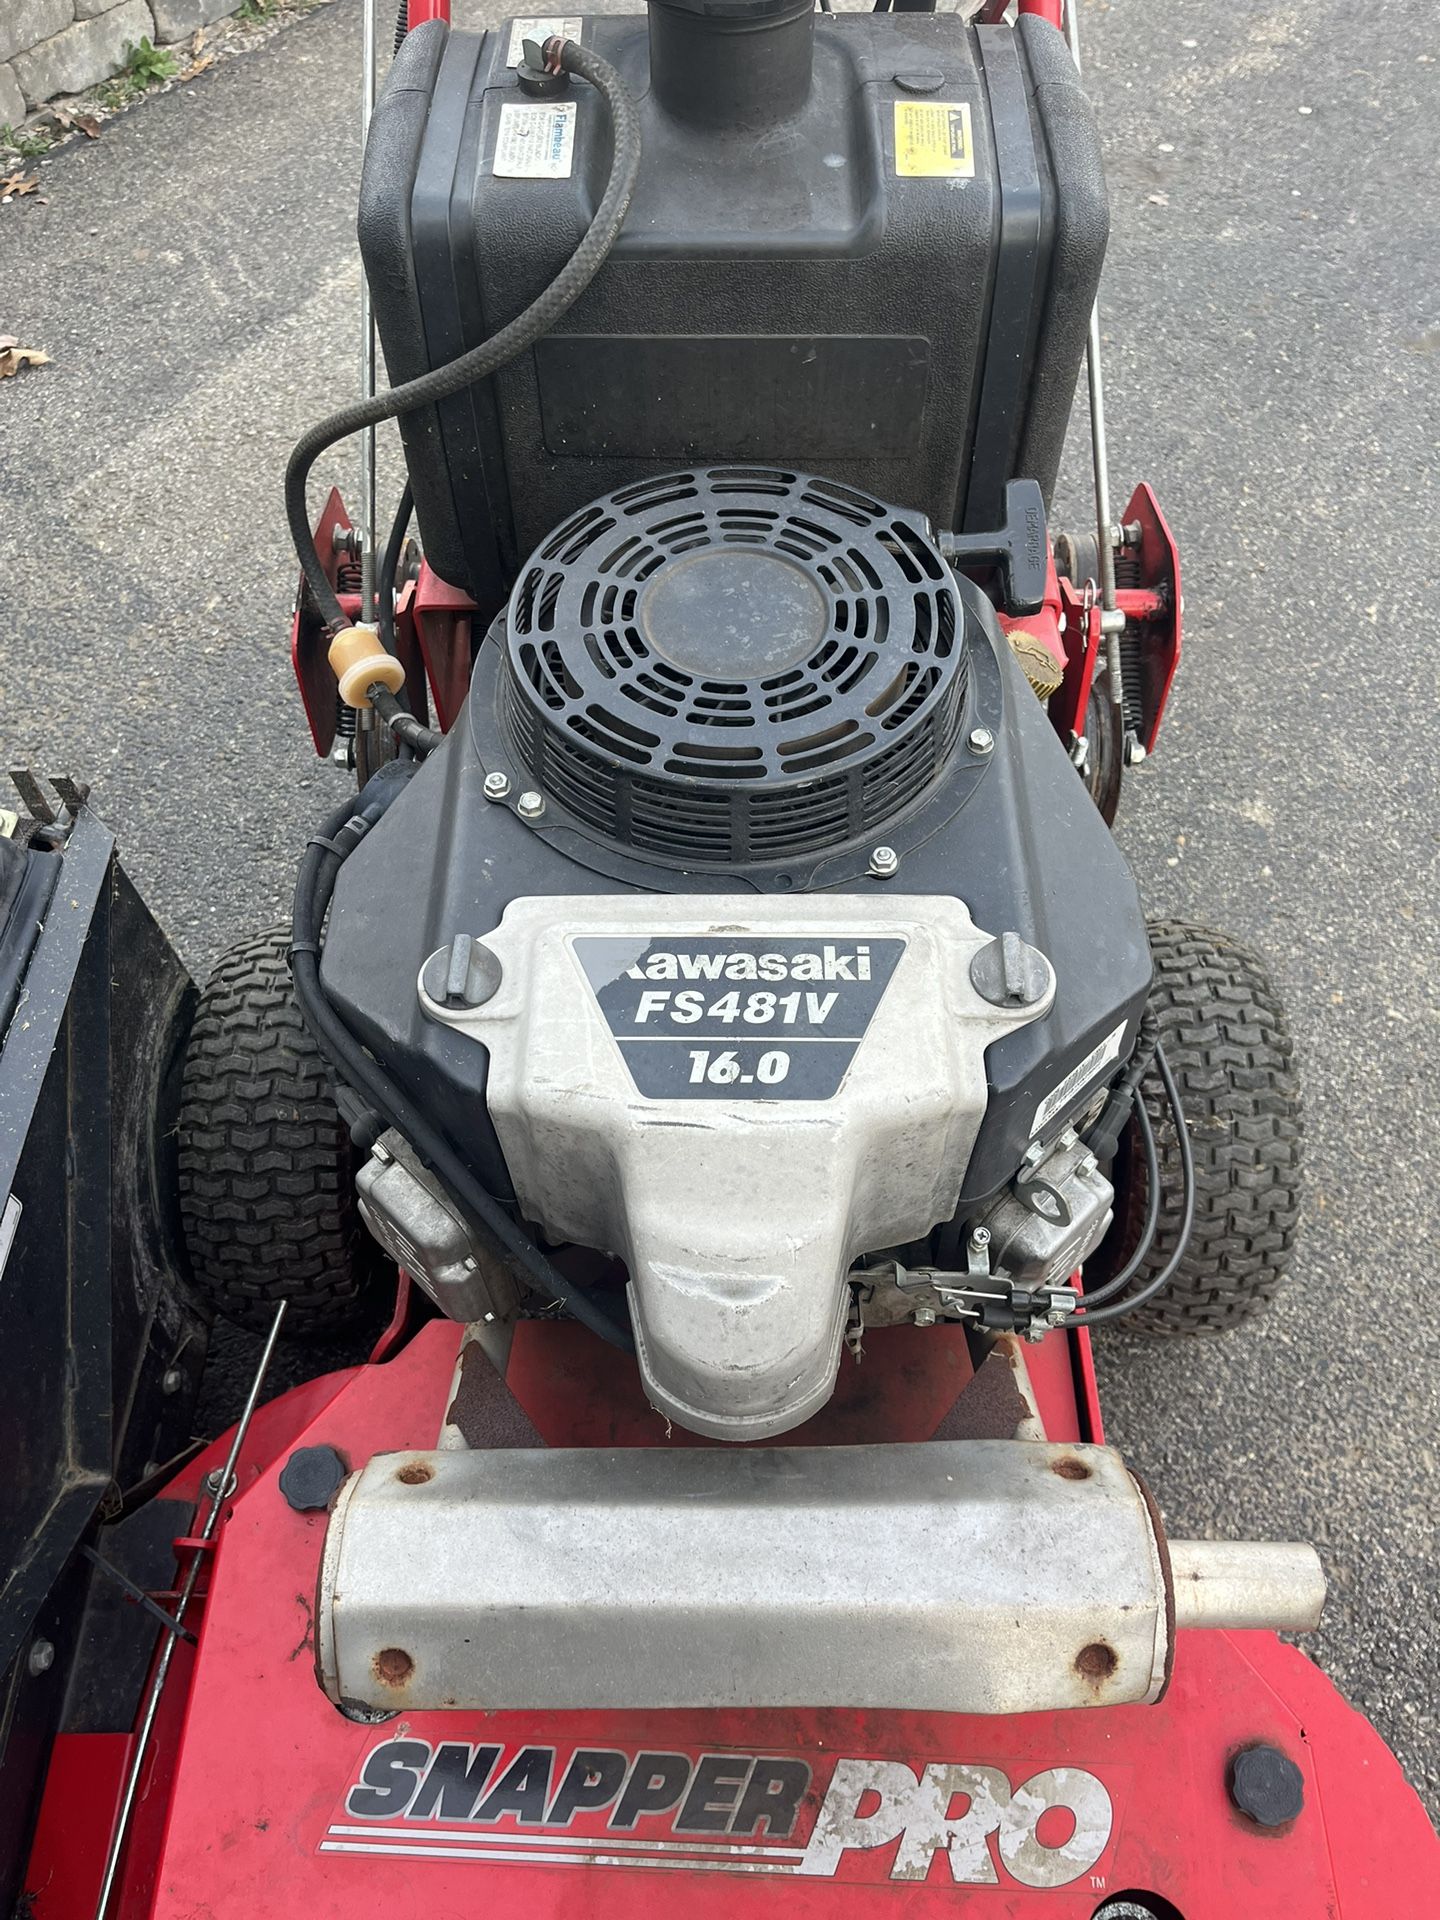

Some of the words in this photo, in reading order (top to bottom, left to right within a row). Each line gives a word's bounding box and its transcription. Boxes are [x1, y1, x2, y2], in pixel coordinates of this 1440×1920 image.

[552, 114, 567, 161] Flambeau
[634, 990, 840, 1024] FS481V
[689, 1050, 791, 1084] 16.0
[344, 1737, 813, 1839] SNAPPER
[796, 1758, 1113, 1888] PRO
